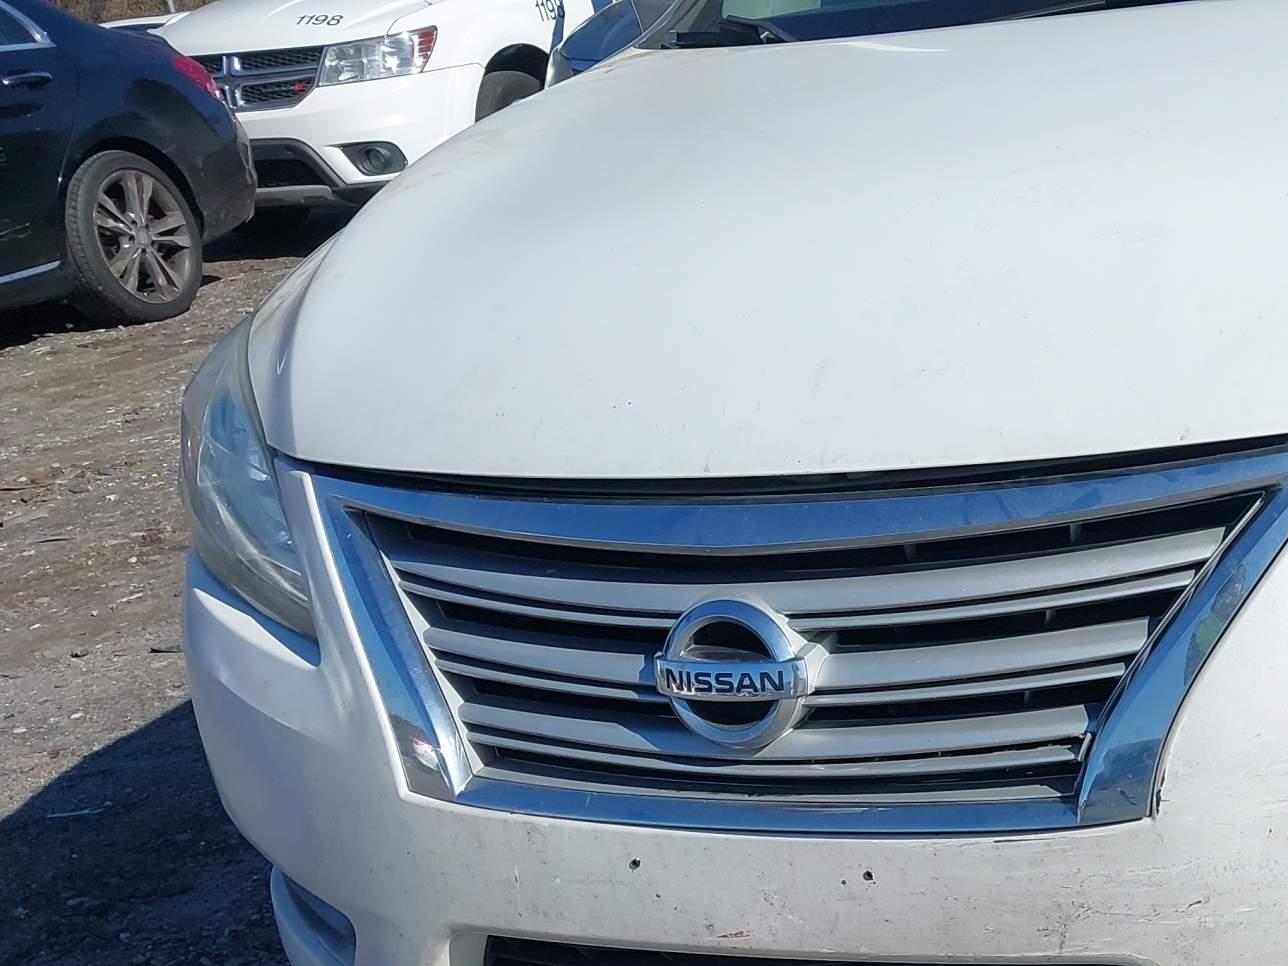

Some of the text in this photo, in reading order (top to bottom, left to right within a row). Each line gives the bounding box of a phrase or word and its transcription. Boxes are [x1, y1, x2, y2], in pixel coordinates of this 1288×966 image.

[296, 14, 344, 26] 1198
[535, 0, 565, 22] 1198
[664, 668, 785, 694] NISSAN
